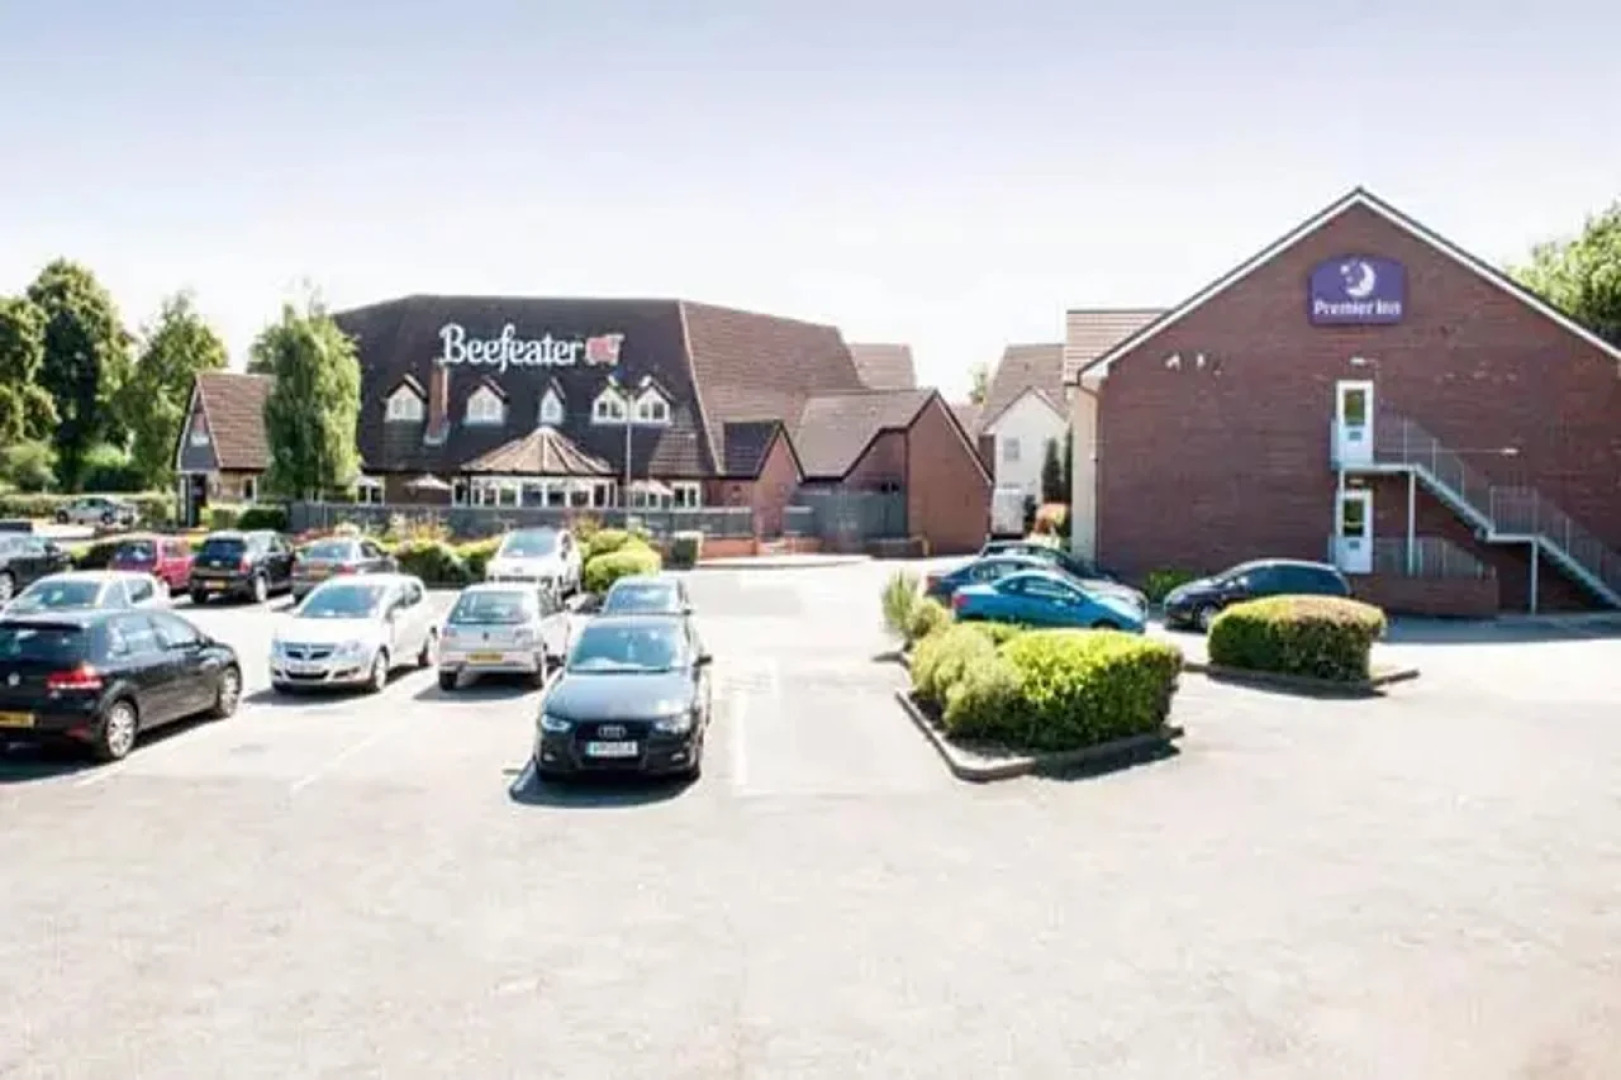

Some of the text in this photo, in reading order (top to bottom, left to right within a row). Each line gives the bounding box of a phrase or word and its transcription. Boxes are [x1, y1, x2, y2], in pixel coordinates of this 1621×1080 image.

[1314, 299, 1402, 315] Premier Inn
[438, 322, 584, 373] Beefeater
